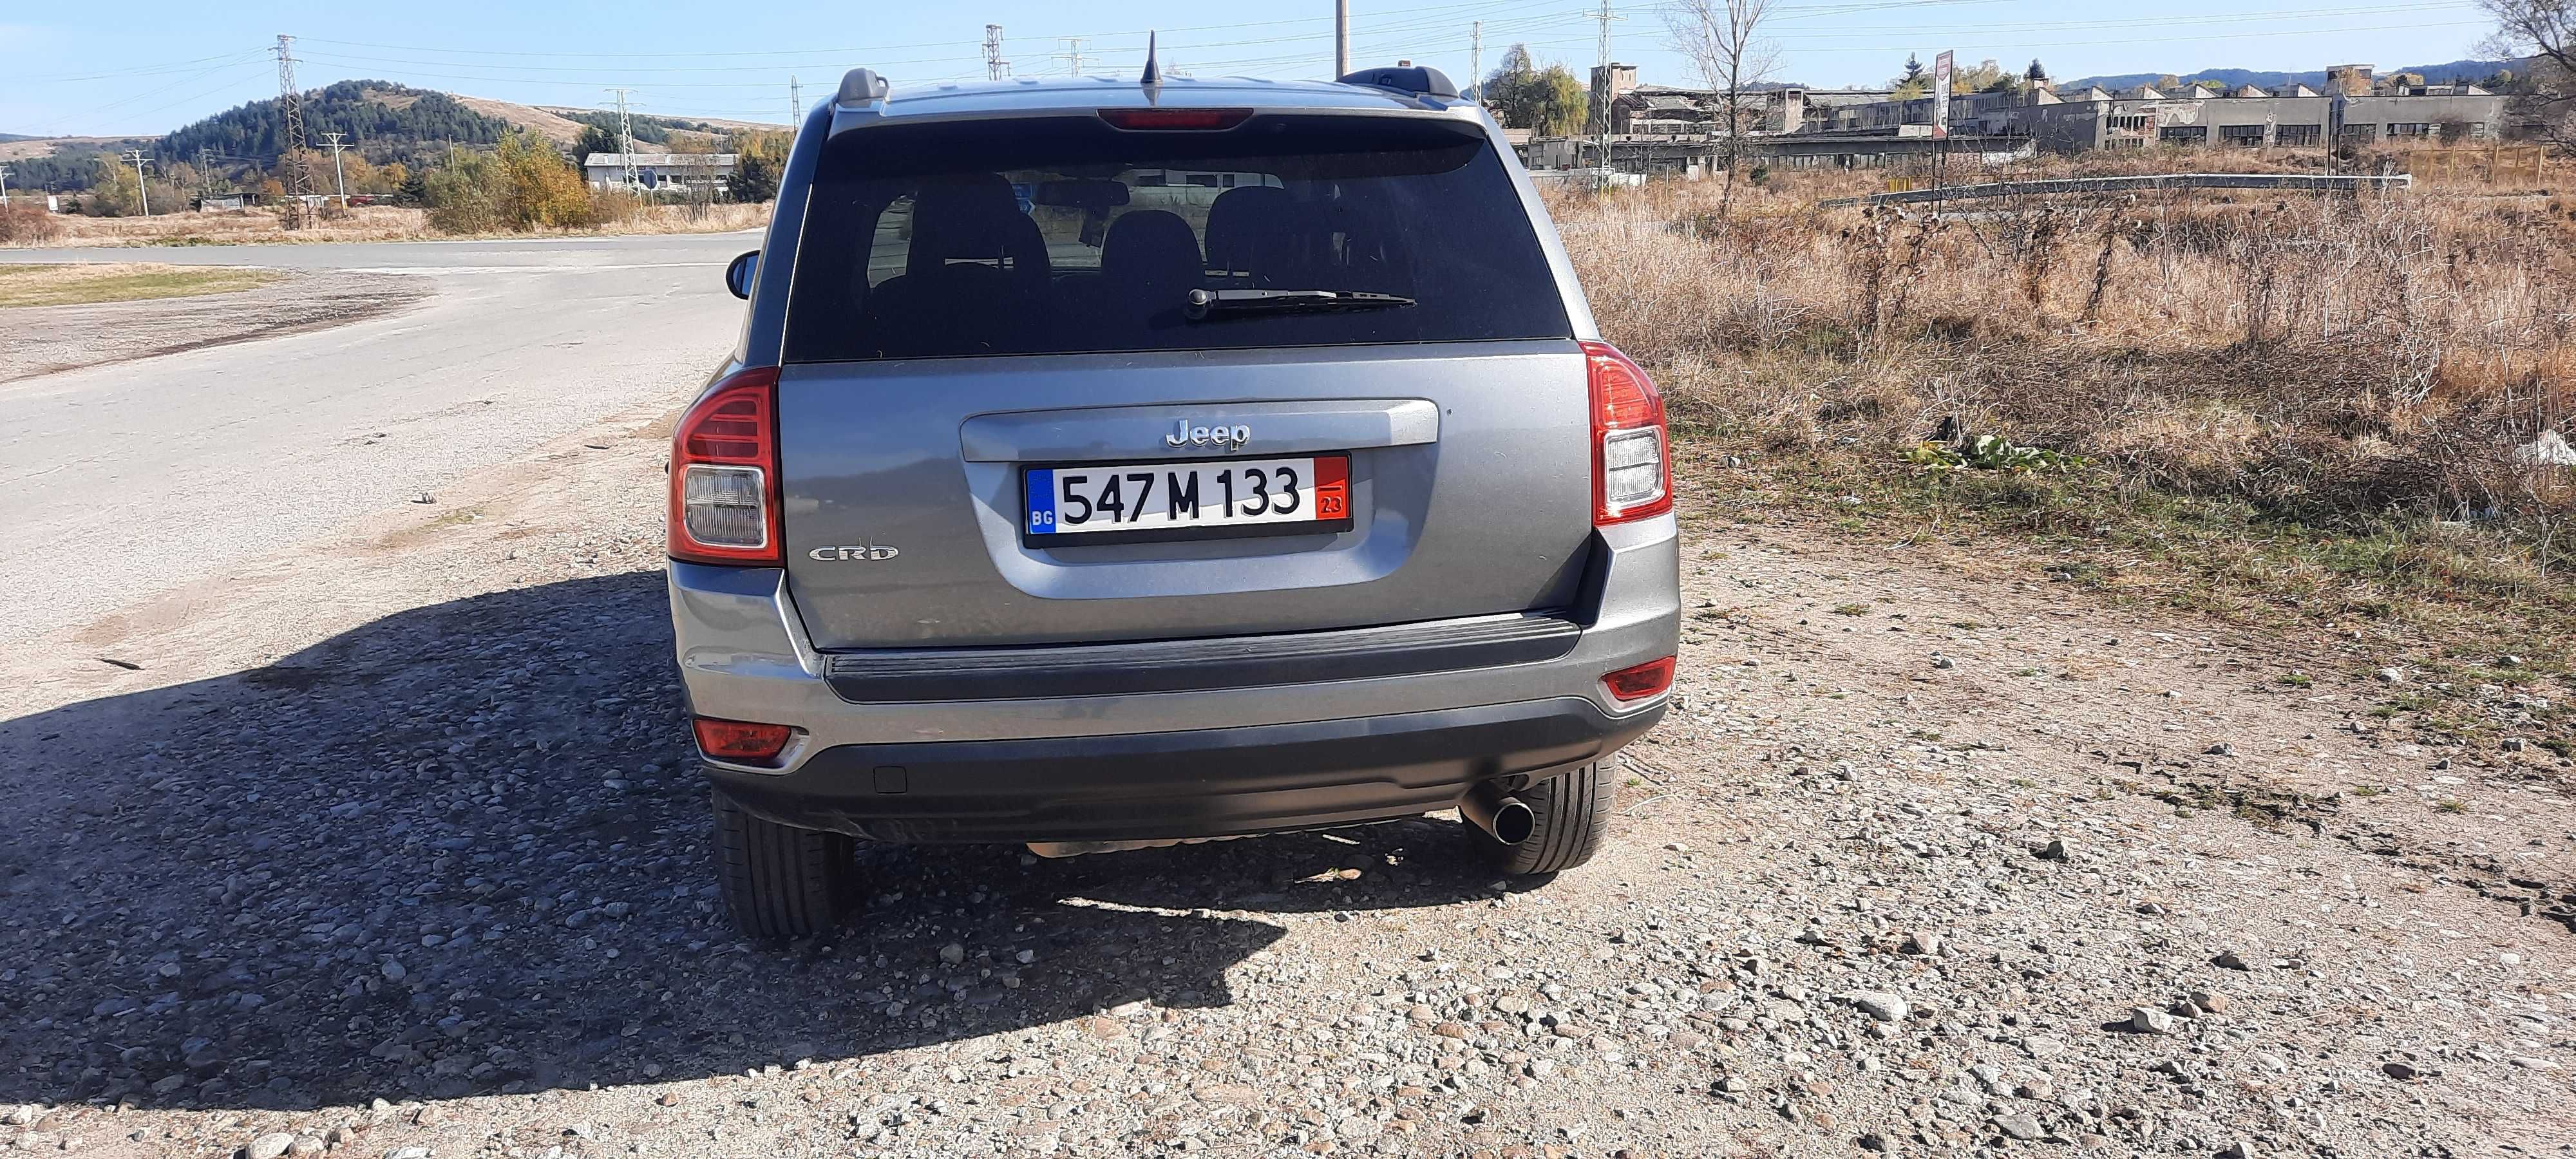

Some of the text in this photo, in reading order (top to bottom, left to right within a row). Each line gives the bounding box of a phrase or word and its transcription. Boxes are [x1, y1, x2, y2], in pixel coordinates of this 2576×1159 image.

[1166, 419, 1251, 451] Jeep
[1063, 467, 1300, 525] 547 M 133
[1320, 495, 1343, 514] 23
[1032, 511, 1053, 526] BG
[809, 545, 899, 561] CRD
